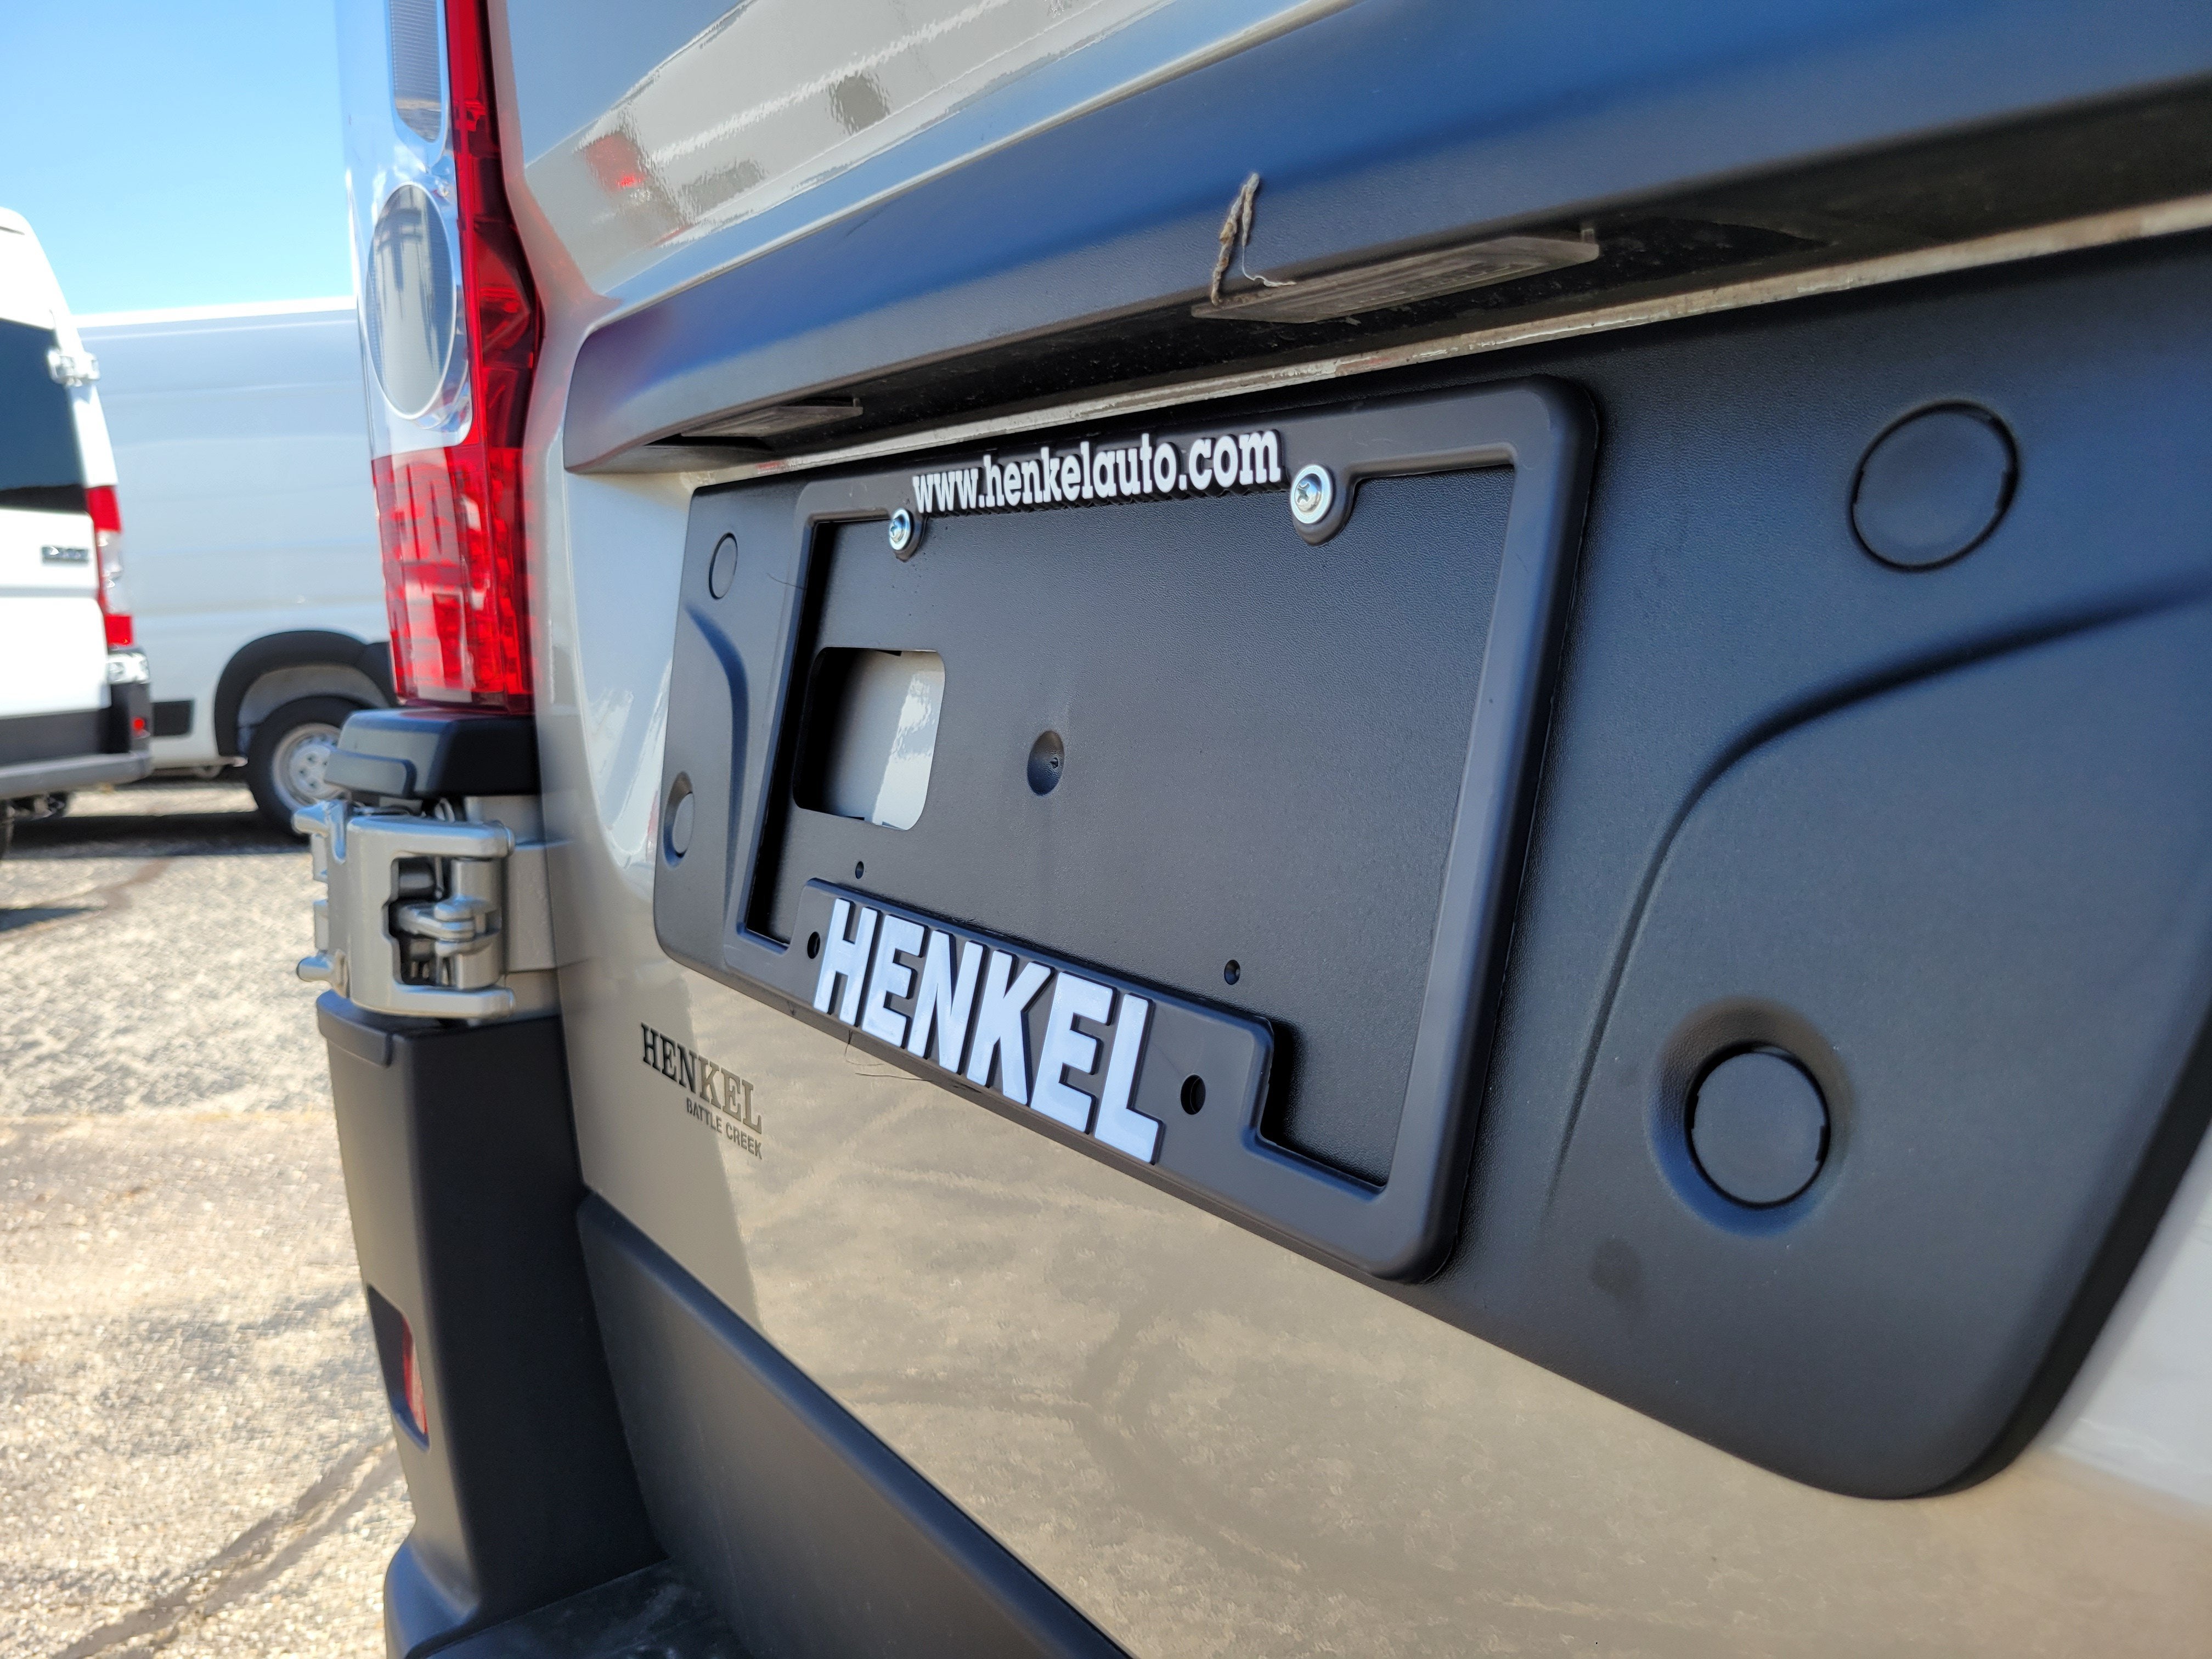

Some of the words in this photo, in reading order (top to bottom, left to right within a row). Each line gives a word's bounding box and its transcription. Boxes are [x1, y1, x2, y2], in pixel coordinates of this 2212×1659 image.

[912, 428, 1282, 514] www.henkelauto.com
[640, 1022, 762, 1134] HENKEL
[813, 898, 1162, 1164] HENKEL
[686, 1097, 723, 1134] BATTLE
[726, 1122, 763, 1159] CREEK
